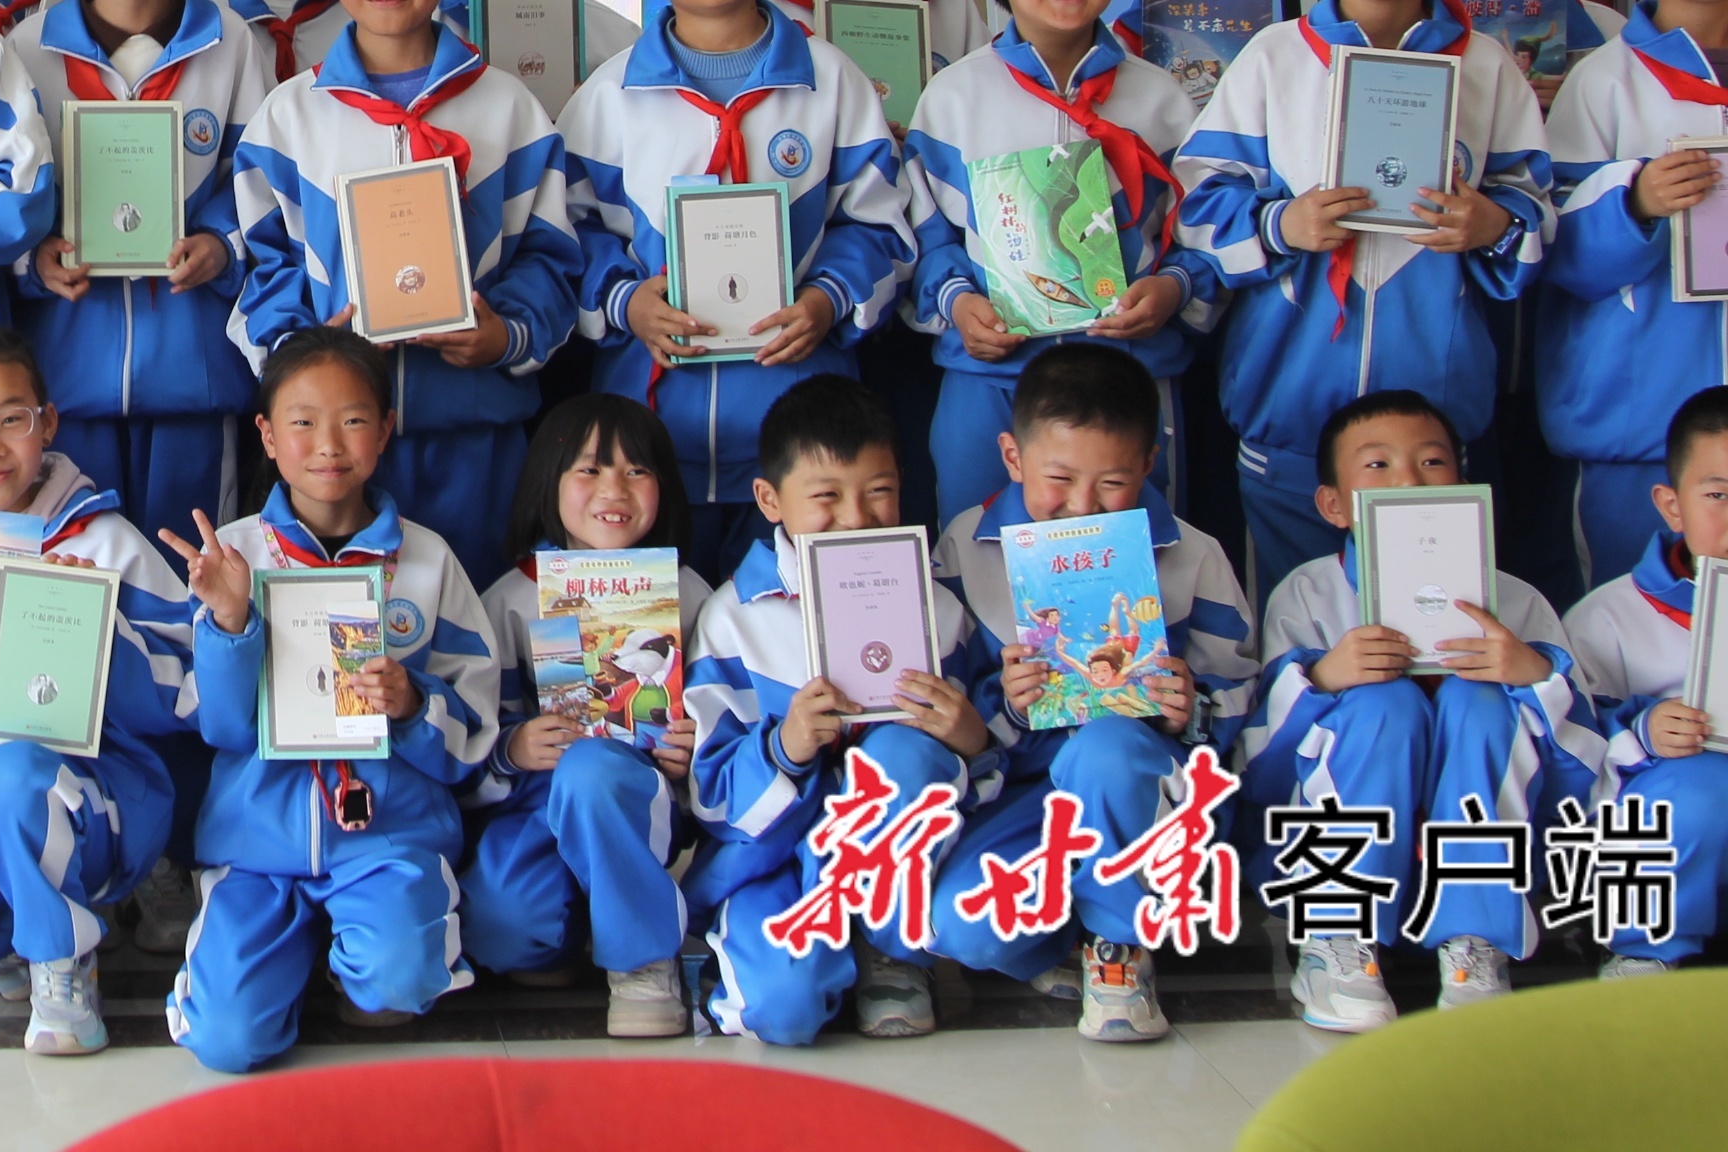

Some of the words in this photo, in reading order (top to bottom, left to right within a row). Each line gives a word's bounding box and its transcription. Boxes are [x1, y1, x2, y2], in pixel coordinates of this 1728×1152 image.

[516, 11, 545, 19] 城南旧事
[1367, 96, 1427, 108] 八十天环游地球
[99, 146, 154, 154] 了不起的盖茨比
[390, 209, 413, 219] 高老头
[704, 232, 719, 240] 背影
[724, 231, 757, 239] 荷塘月色
[1049, 547, 1117, 574] 水孩子
[565, 577, 652, 597] 柳林风声
[21, 611, 81, 626] 了不起的盖茨比
